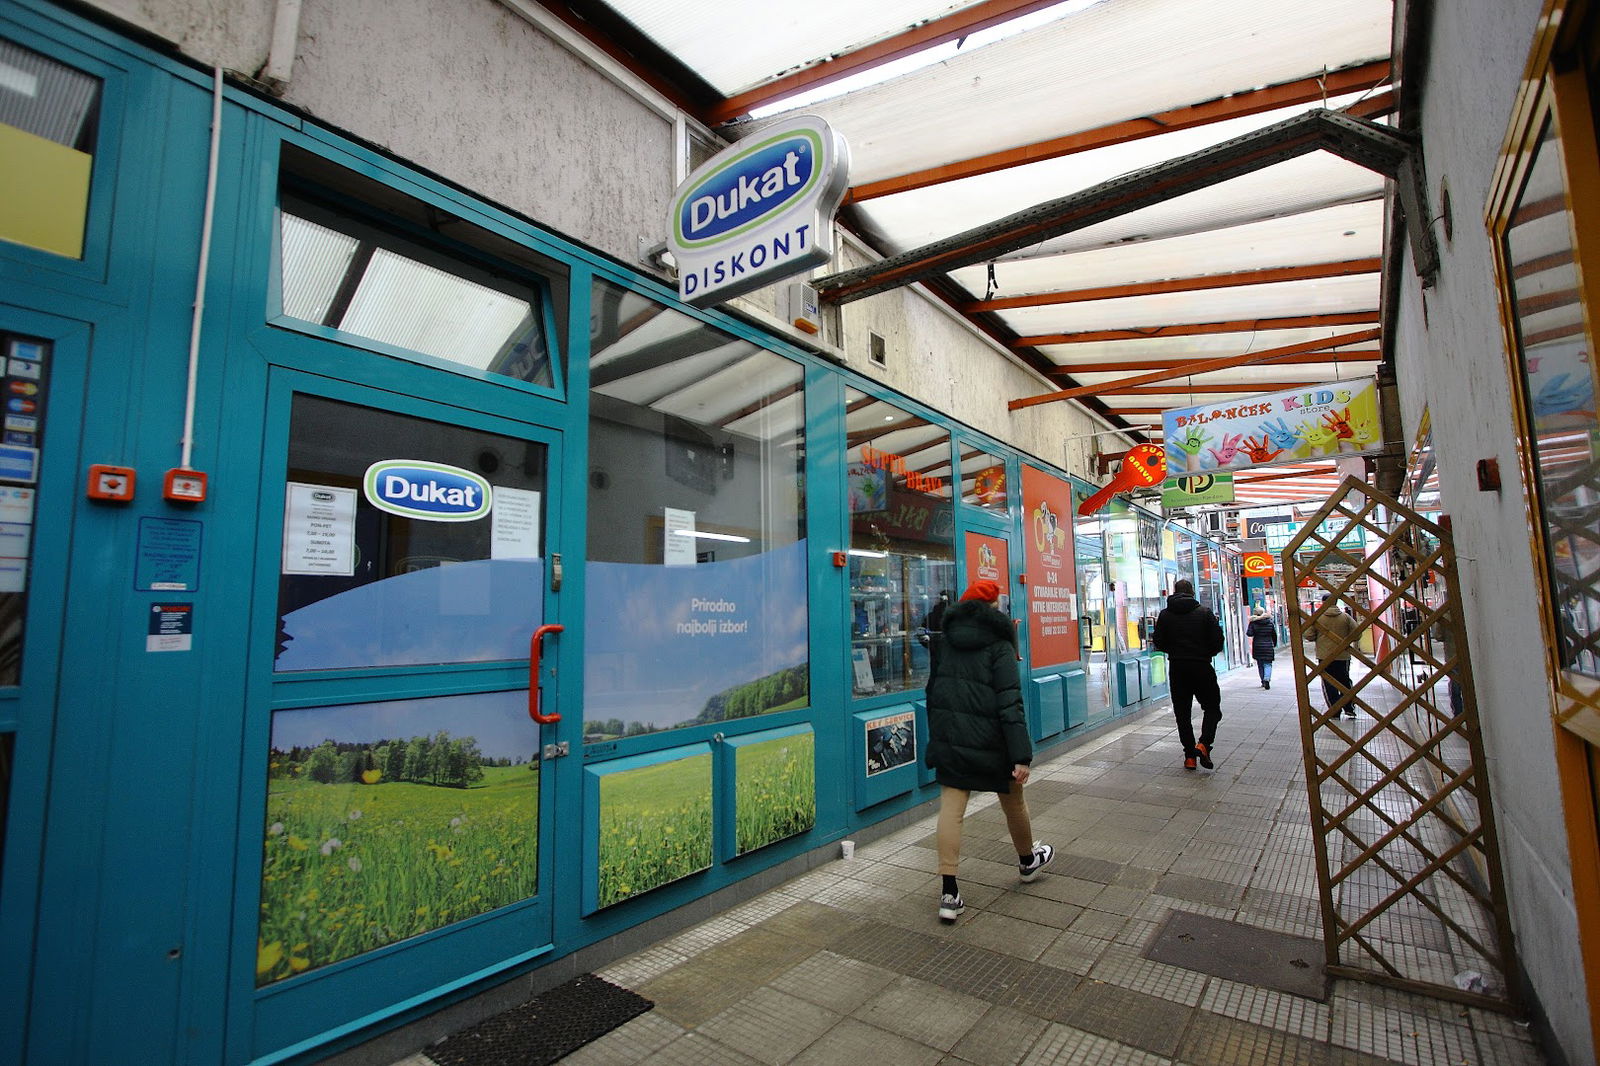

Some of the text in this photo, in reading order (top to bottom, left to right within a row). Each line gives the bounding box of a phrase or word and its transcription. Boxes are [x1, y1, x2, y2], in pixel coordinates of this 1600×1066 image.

[690, 151, 801, 234] Dukat
[685, 224, 810, 296] DISKONT
[1281, 390, 1351, 412] KIDS
[1300, 404, 1331, 415] store
[1142, 446, 1167, 471] SUPER
[384, 474, 478, 508] Dukat
[691, 598, 736, 613] Prirodno
[677, 620, 748, 637] najbolji izbor!
